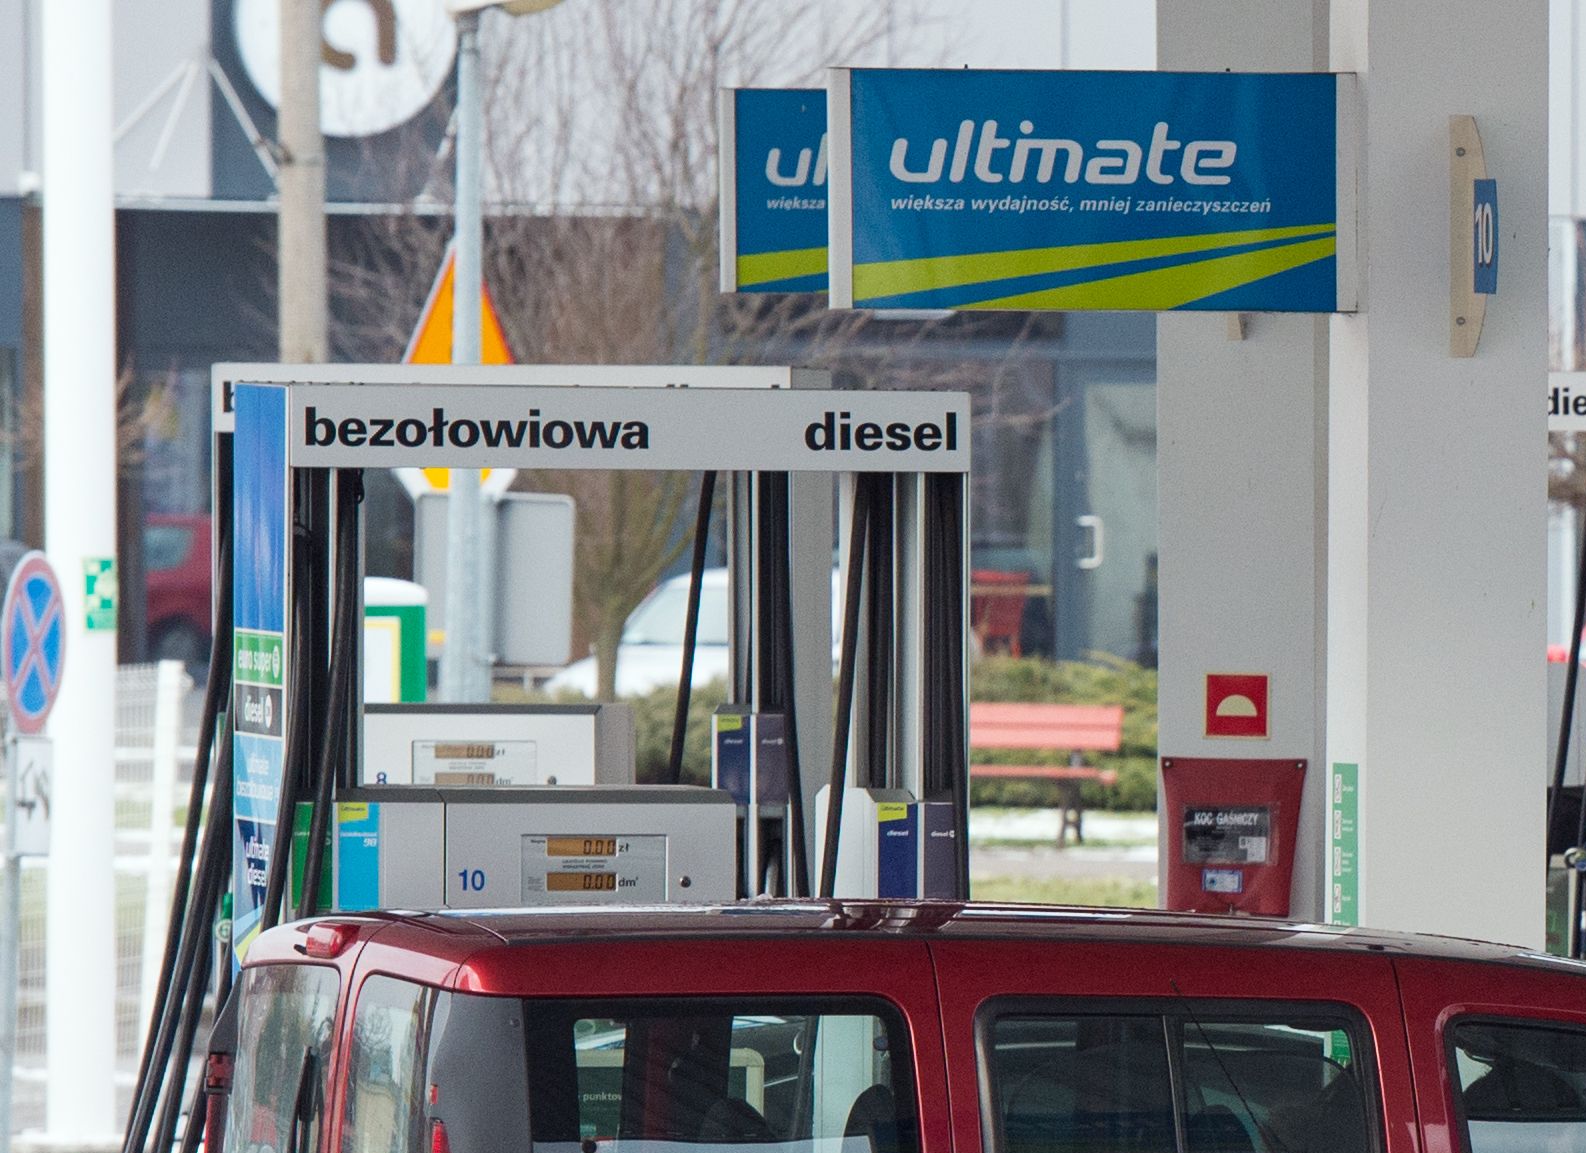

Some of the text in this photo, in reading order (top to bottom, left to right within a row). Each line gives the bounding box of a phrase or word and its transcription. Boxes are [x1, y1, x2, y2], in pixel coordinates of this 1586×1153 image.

[889, 119, 1238, 185] ultimate
[891, 194, 1271, 215] większa wydajność, mniej zanieczyszczeń
[1474, 202, 1494, 268] 10
[304, 406, 958, 451] bezołowiowa diesel
[1194, 812, 1213, 825] KOC
[458, 869, 485, 891] 10
